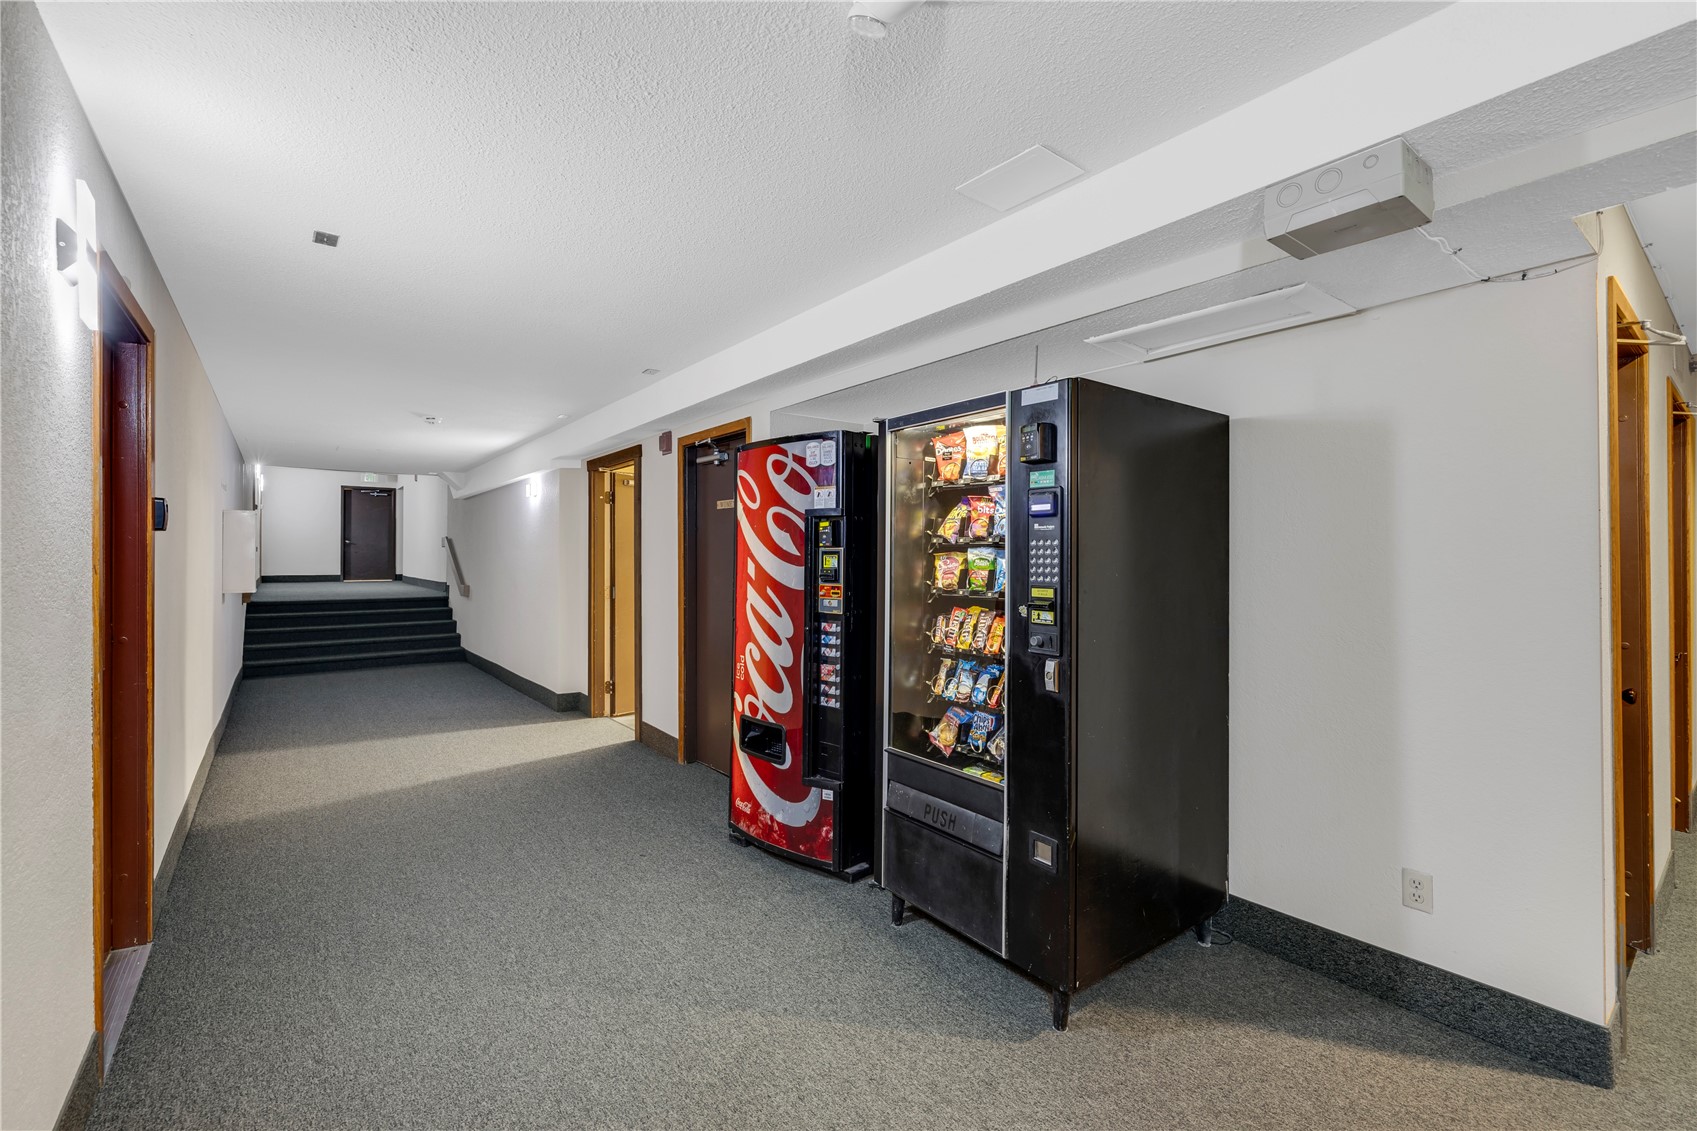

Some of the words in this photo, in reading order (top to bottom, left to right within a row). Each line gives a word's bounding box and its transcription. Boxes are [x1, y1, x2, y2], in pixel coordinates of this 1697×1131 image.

[935, 444, 963, 456] Doritos
[977, 505, 995, 514] bits
[923, 803, 957, 832] PUSH
